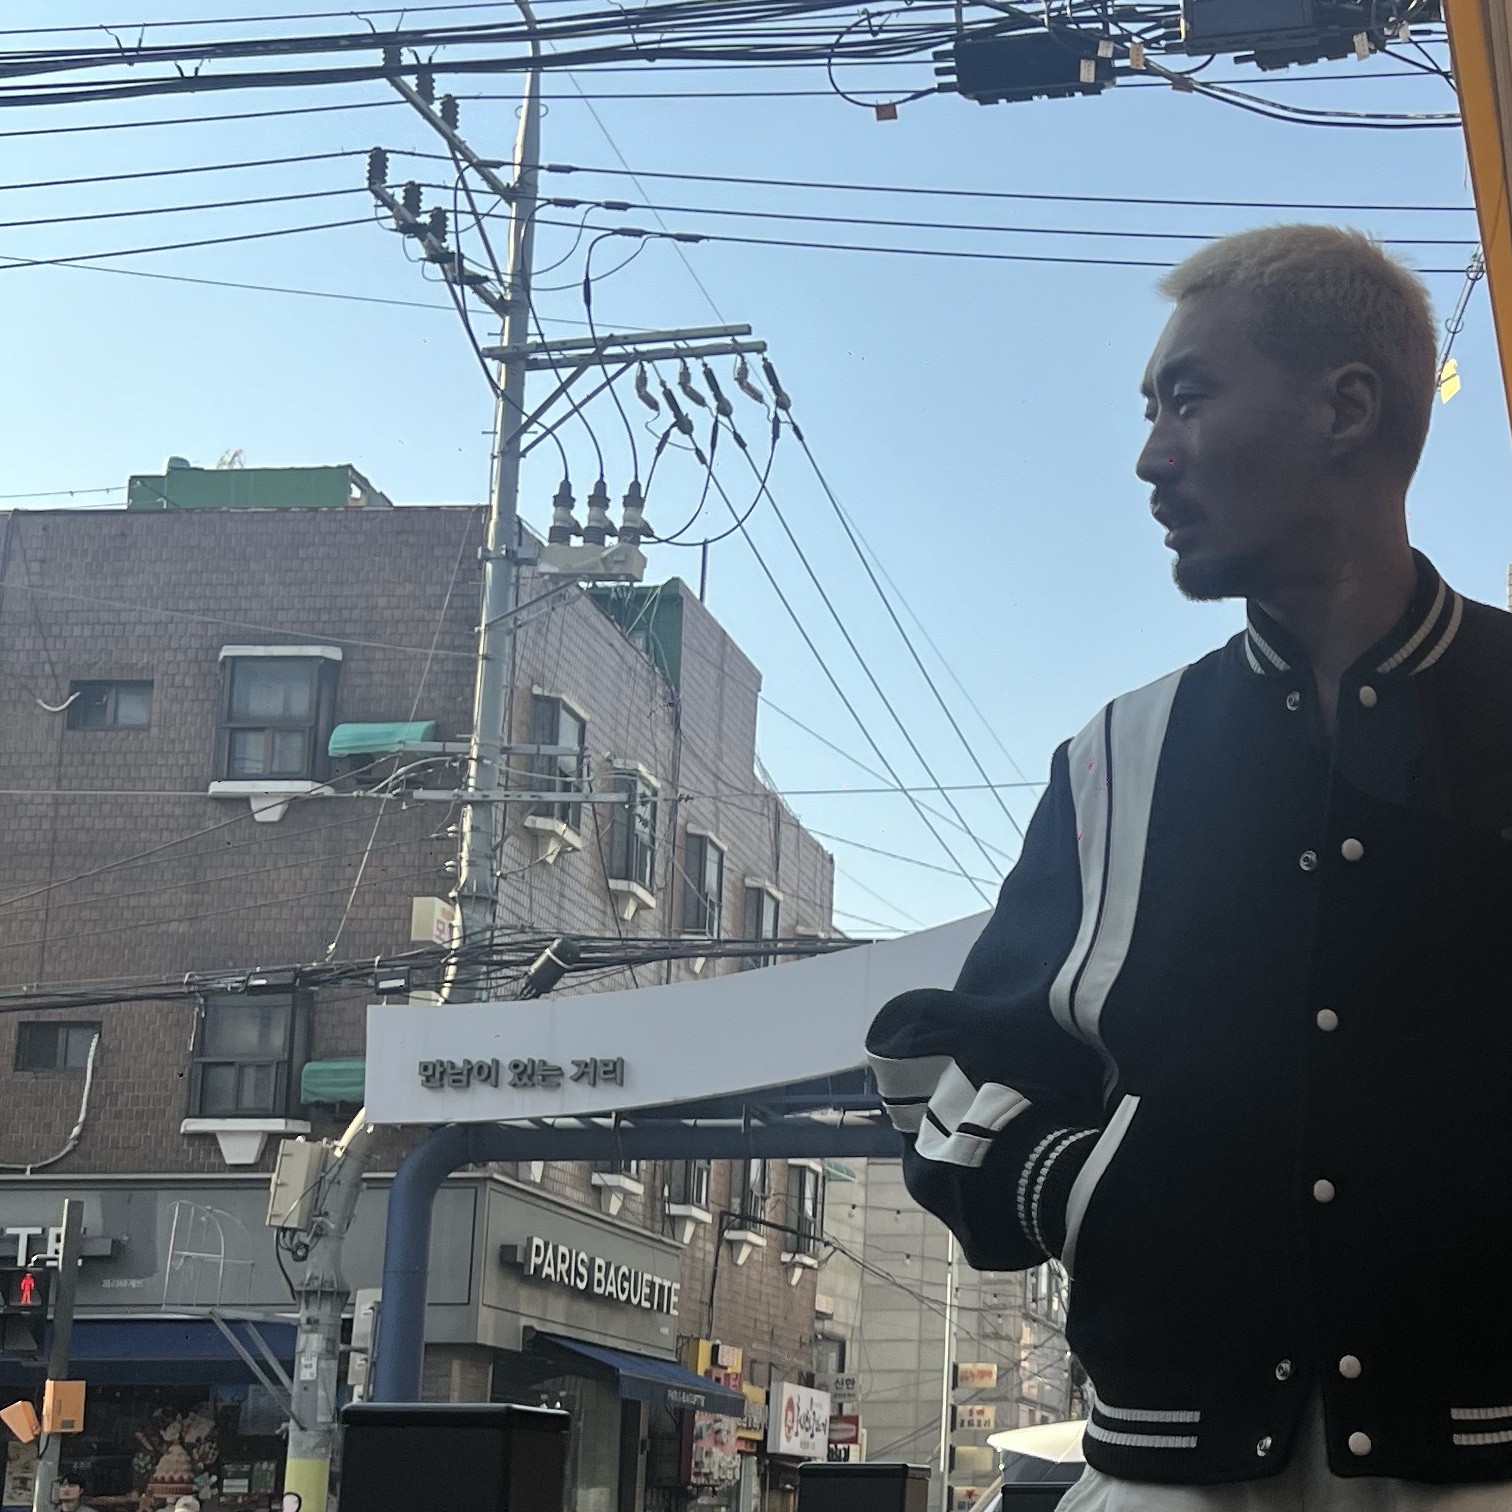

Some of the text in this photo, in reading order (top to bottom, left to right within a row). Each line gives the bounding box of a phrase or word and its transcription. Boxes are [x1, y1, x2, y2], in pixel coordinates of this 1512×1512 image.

[418, 1056, 625, 1088] 만남이 있는 거리
[530, 1236, 681, 1316] PARIS BAGUETTE
